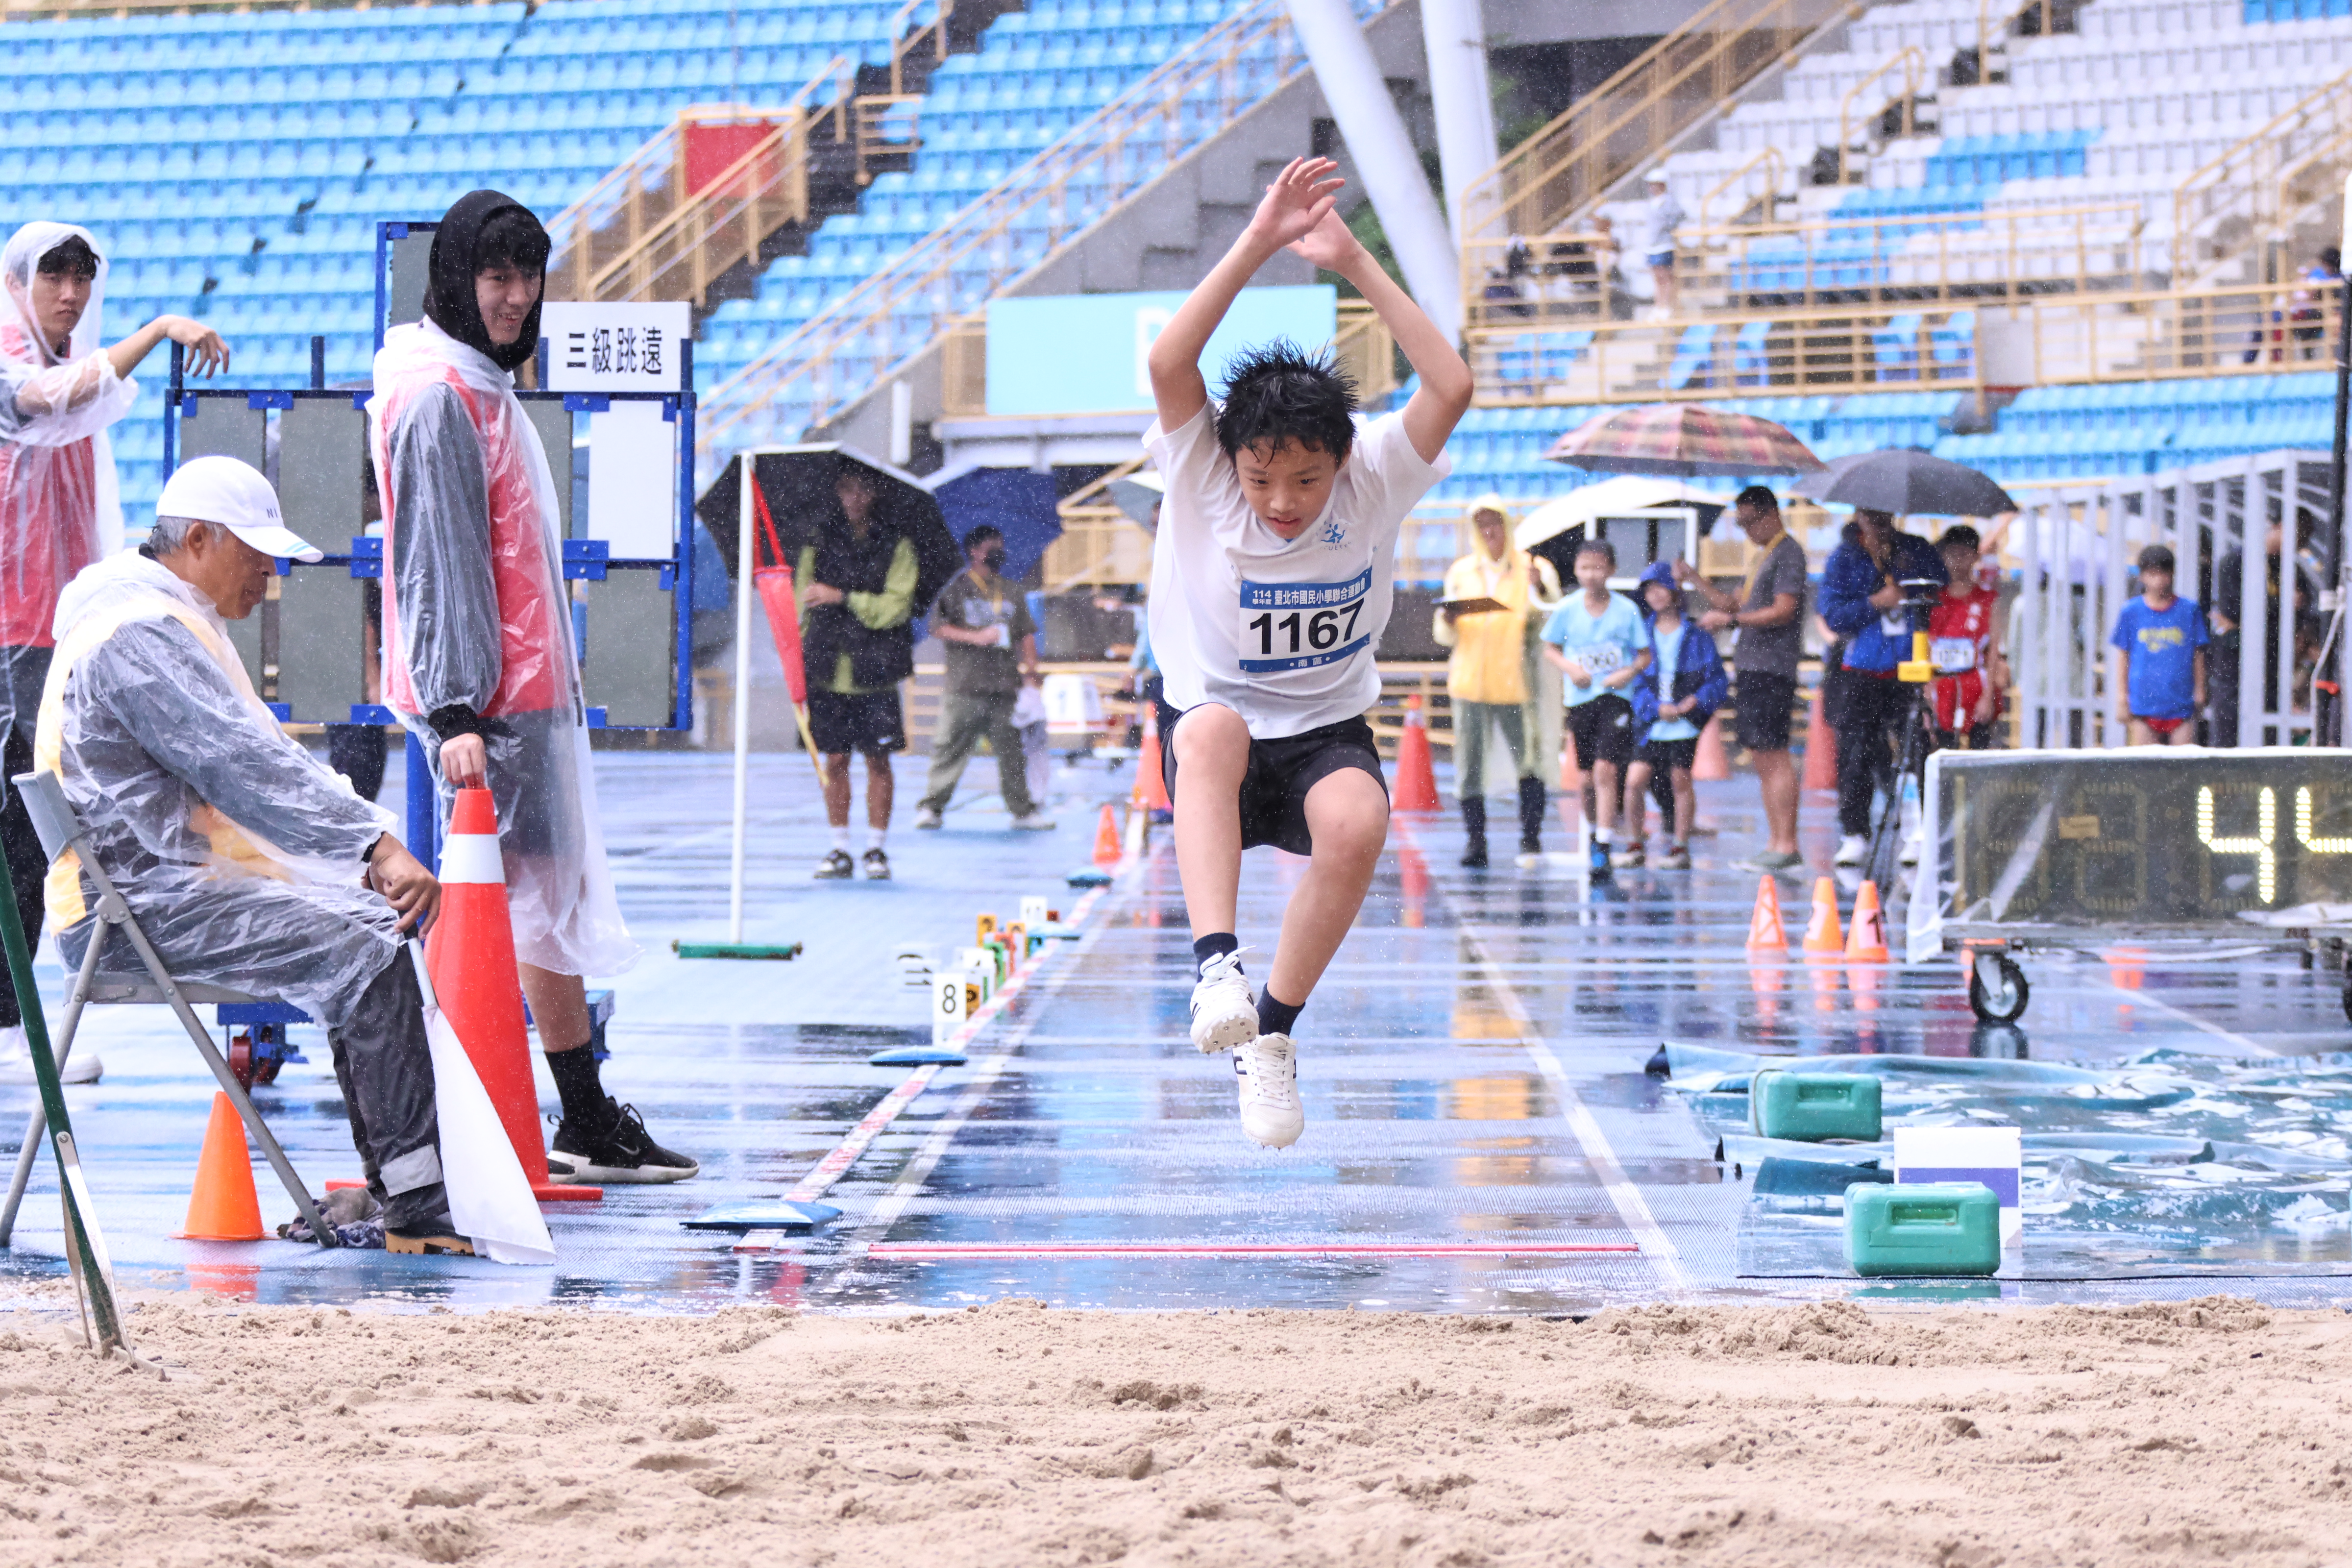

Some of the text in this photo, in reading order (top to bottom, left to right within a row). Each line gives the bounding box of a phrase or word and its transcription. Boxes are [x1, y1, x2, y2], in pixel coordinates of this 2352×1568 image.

[567, 326, 662, 374] 三級跳遠
[1274, 577, 1365, 605] 臺北市國民小學聯合運動會
[1250, 597, 1364, 654] 1167
[942, 983, 956, 1013] 8
